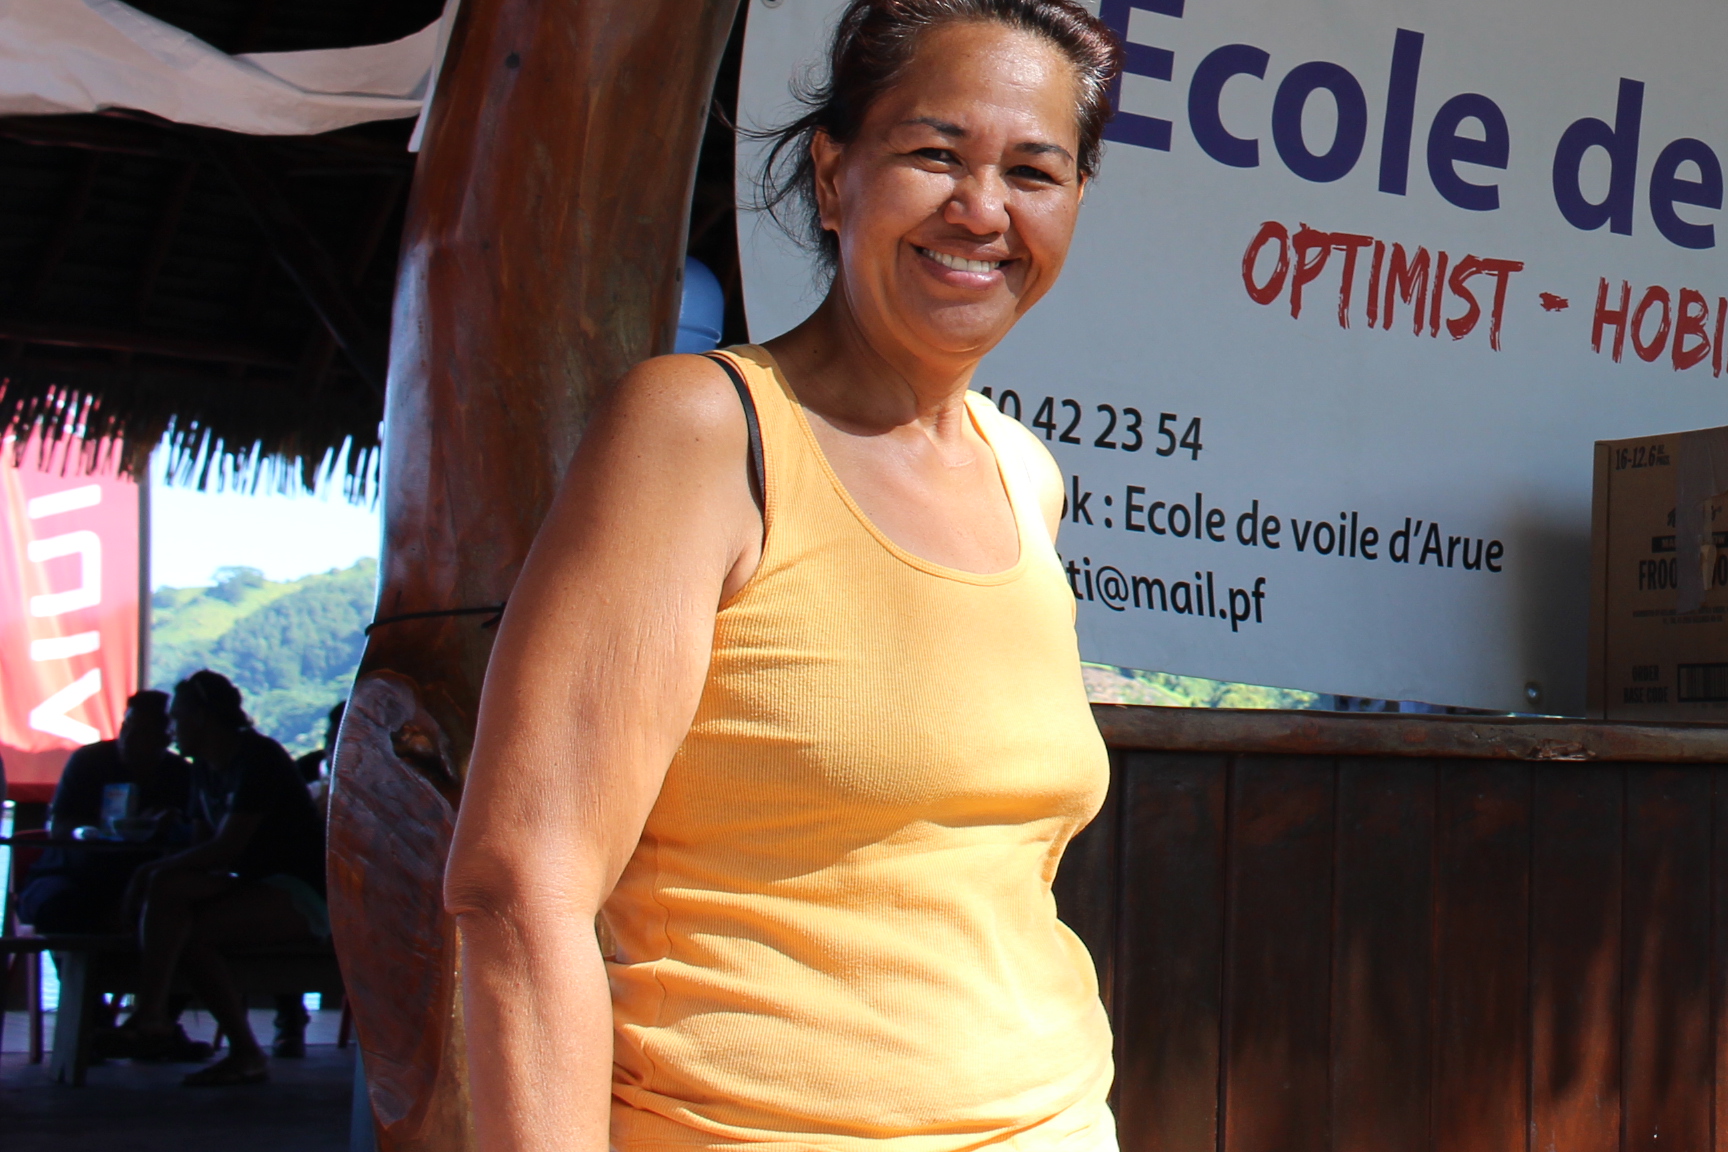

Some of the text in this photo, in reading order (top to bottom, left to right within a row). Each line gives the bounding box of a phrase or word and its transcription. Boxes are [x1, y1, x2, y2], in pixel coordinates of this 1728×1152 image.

[1552, 77, 1723, 250] de
[1242, 219, 1524, 352] OPTIMIST
[1032, 396, 1082, 445] 42
[1093, 403, 1143, 452] 23
[1155, 412, 1203, 461] 54
[1125, 485, 1225, 542] Ecole
[1236, 499, 1281, 549] de
[1291, 511, 1379, 561] voile
[1389, 517, 1504, 573] d'Arue
[1638, 557, 1677, 591] FROO
